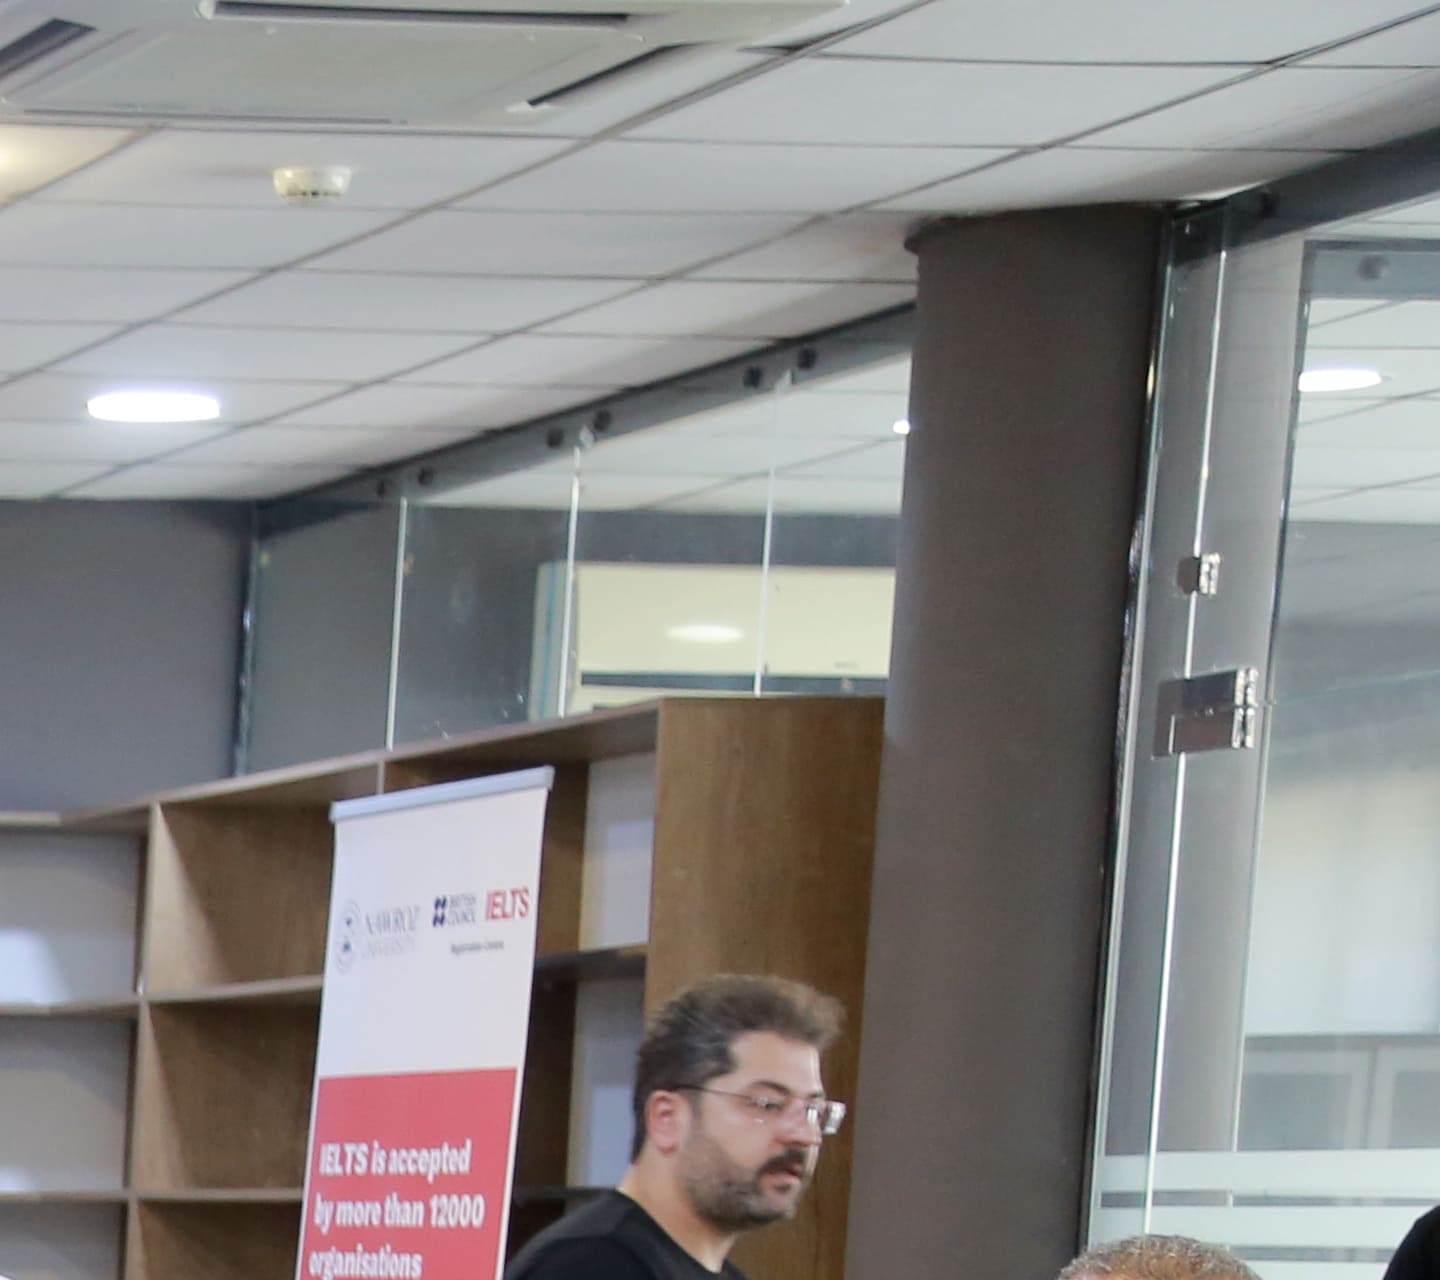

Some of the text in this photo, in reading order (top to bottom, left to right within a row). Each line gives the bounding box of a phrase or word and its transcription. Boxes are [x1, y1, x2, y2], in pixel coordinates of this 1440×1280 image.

[485, 886, 530, 921] IELTS
[319, 1138, 472, 1184] IELTS is accepted
[314, 1192, 486, 1235] by more than 12000
